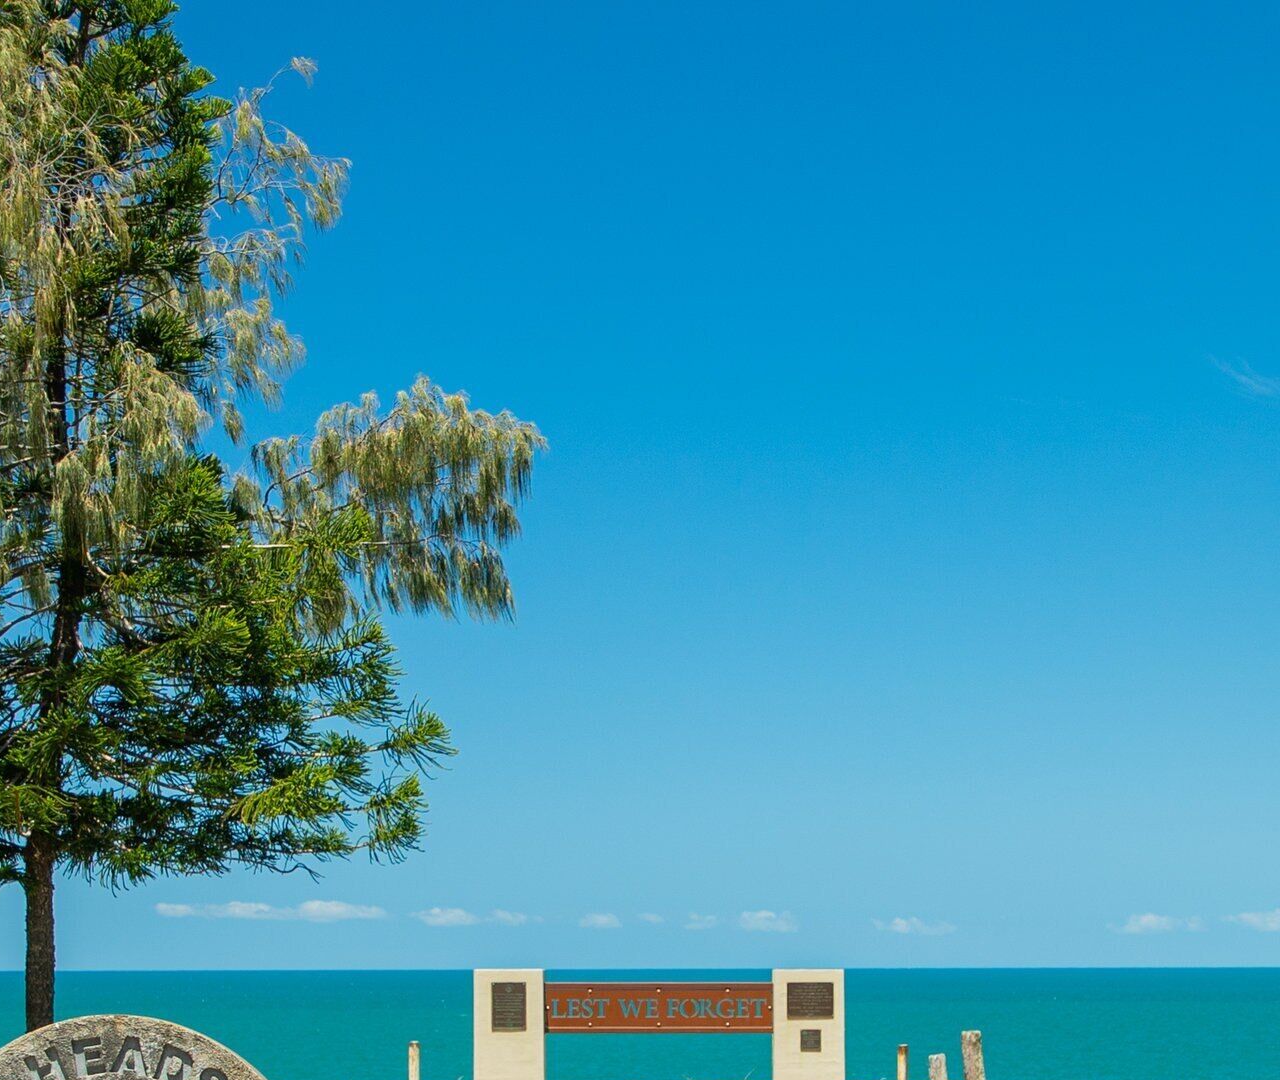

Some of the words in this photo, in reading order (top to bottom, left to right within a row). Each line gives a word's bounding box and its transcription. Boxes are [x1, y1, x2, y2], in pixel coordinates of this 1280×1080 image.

[551, 997, 610, 1019] LEST
[617, 998, 660, 1019] WE
[666, 997, 768, 1019] FORGET
